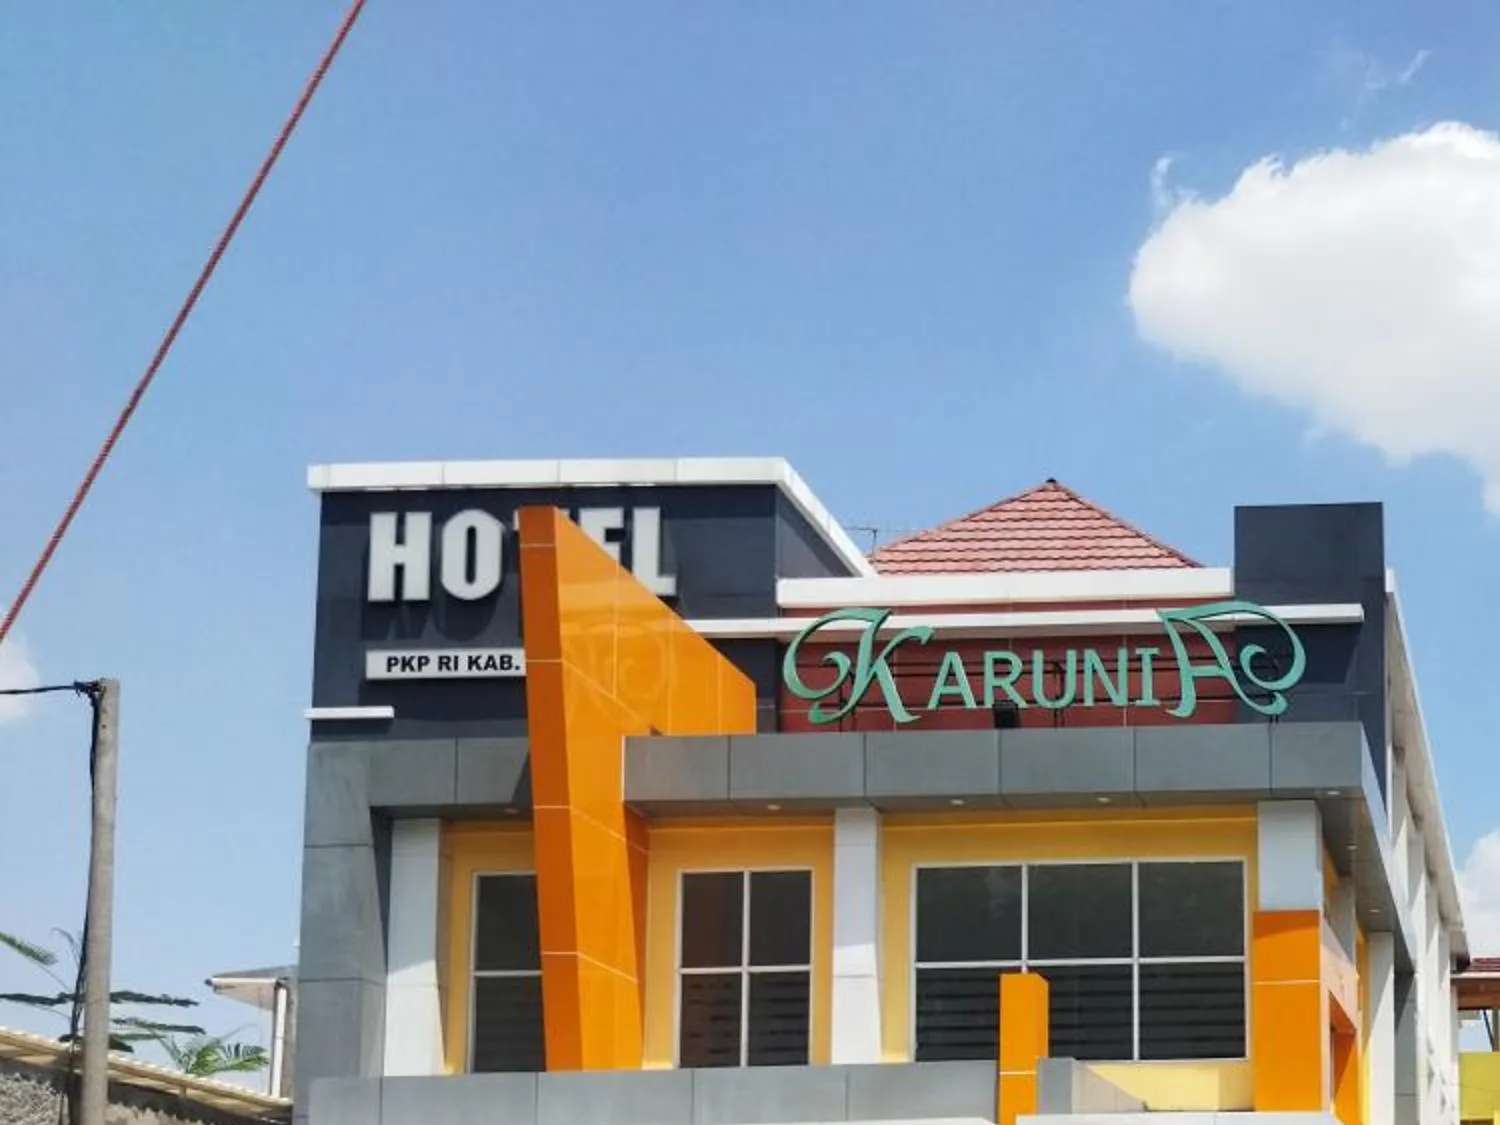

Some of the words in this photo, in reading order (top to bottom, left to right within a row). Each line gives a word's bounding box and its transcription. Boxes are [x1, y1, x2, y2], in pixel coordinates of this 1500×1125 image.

[368, 507, 676, 601] HOL
[386, 655, 430, 672] PKP
[437, 655, 459, 672] RI
[467, 654, 521, 671] KAB.
[783, 601, 1306, 723] KARUNIA
